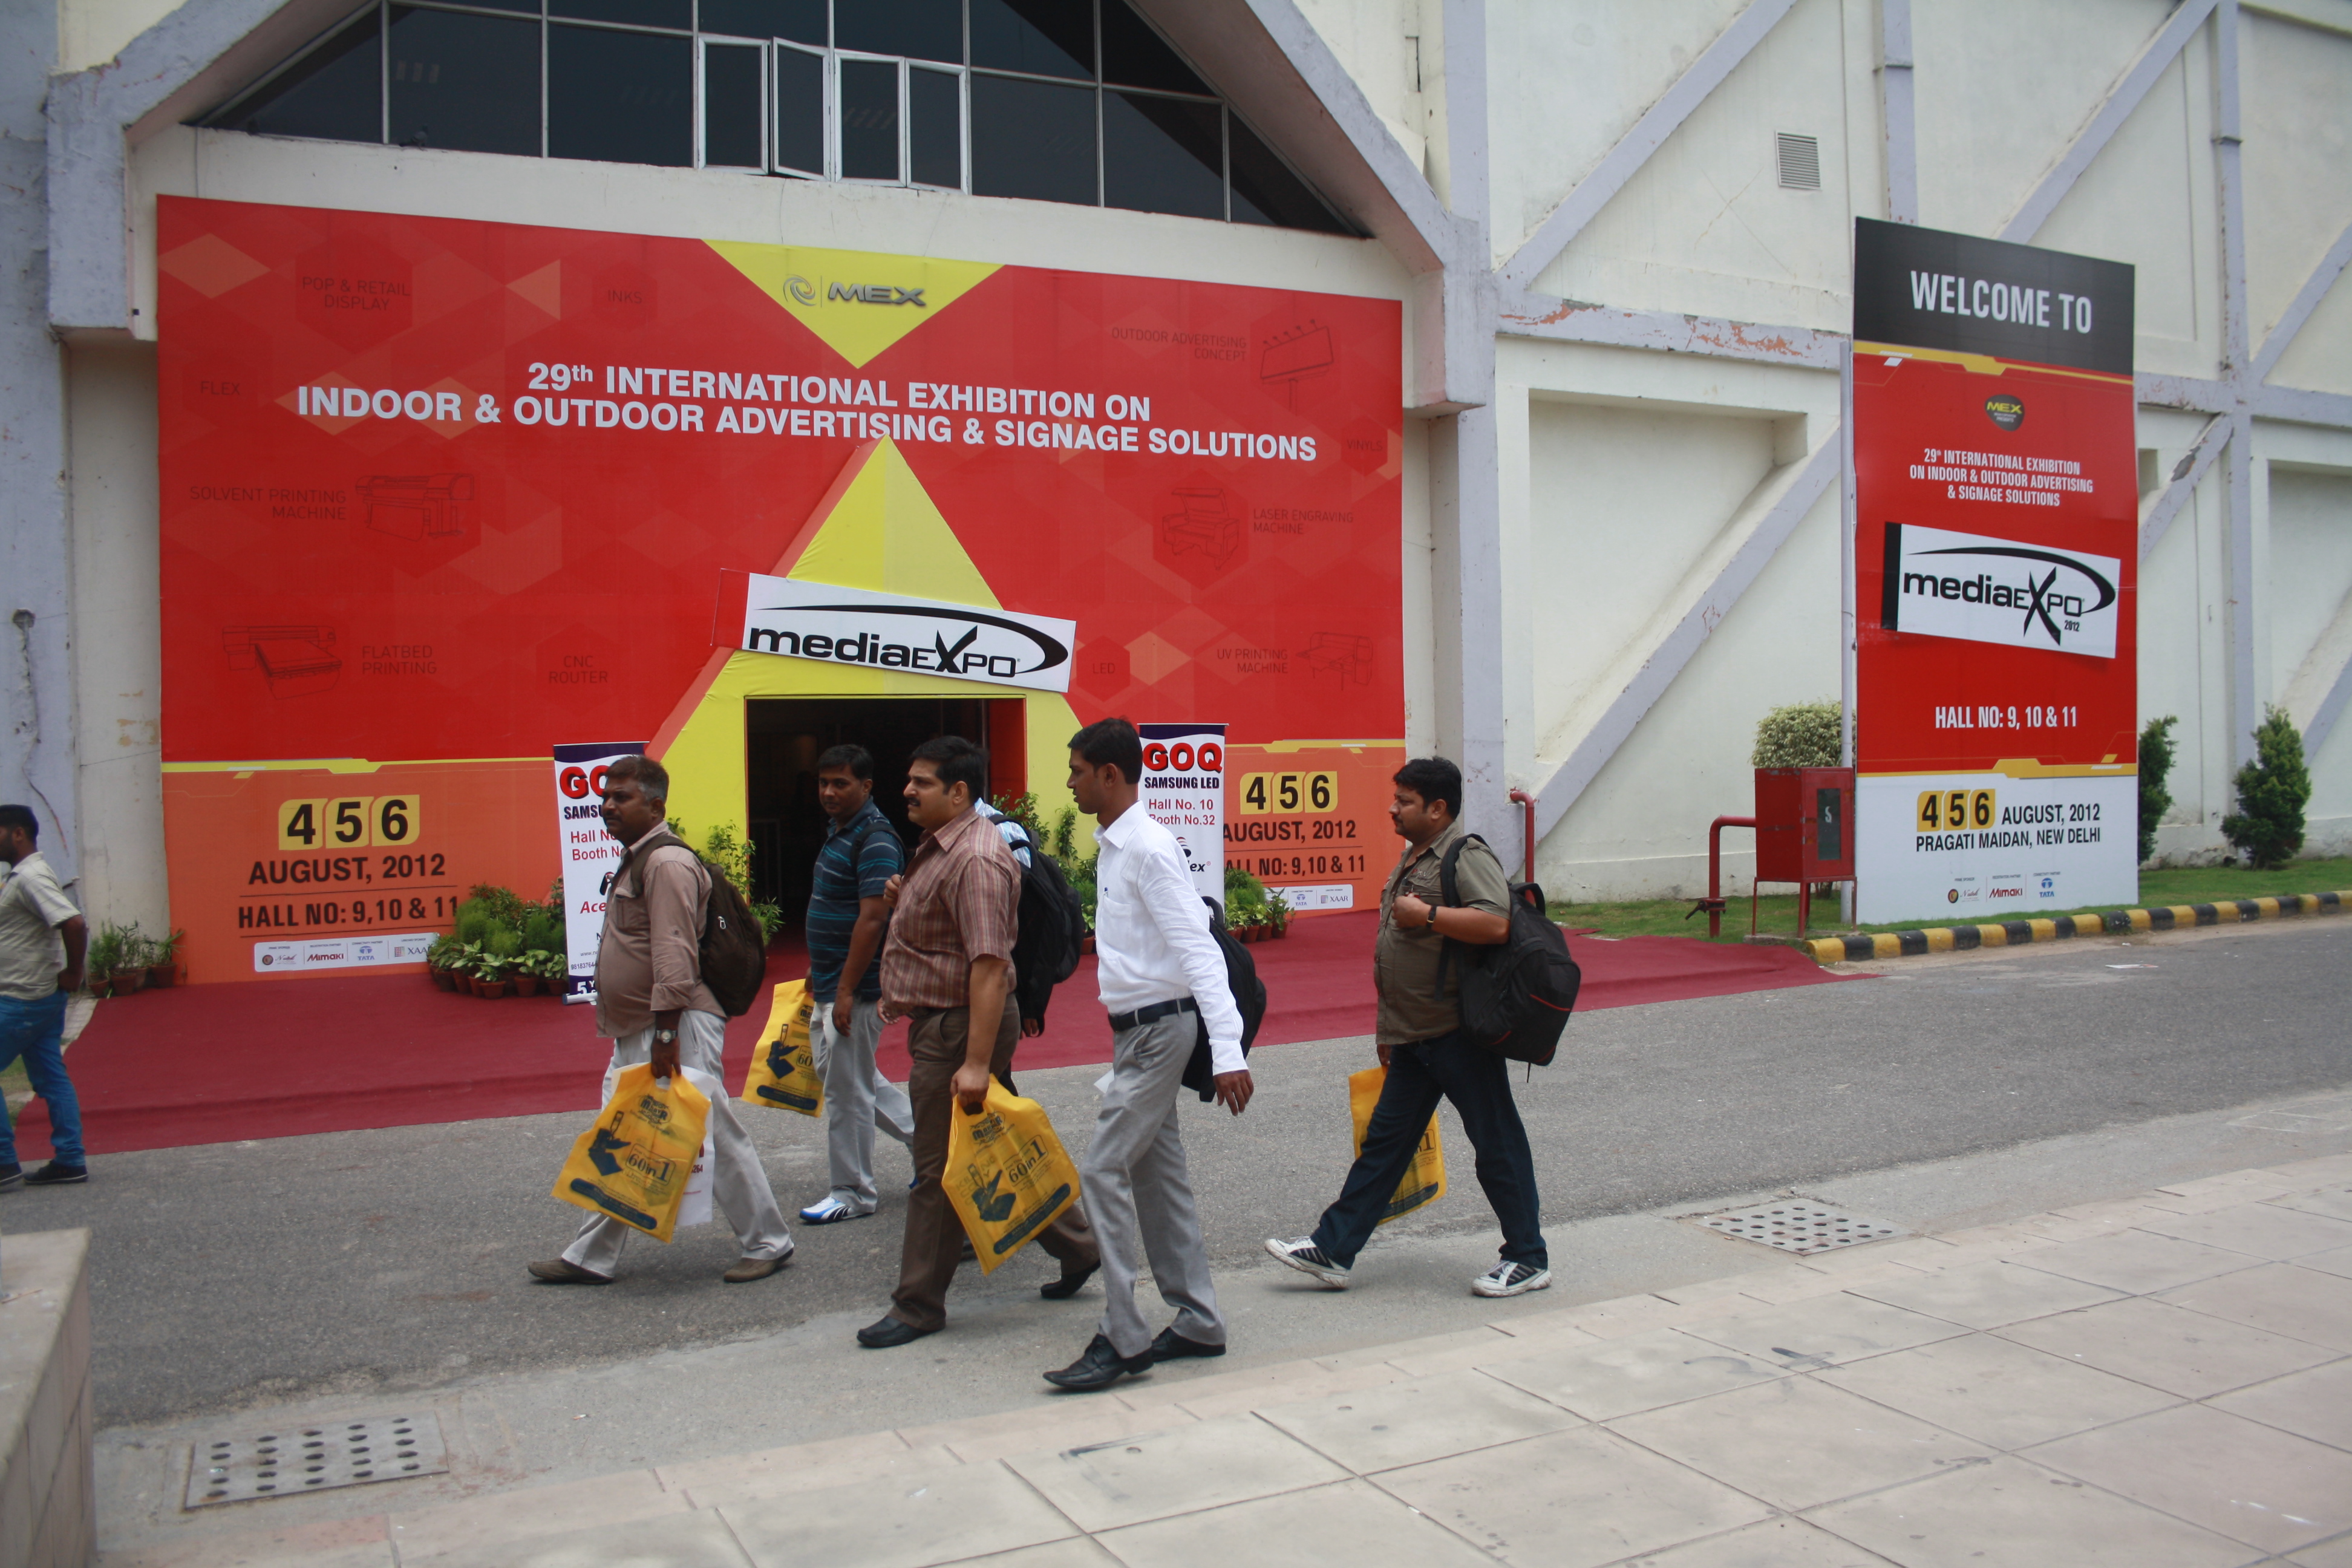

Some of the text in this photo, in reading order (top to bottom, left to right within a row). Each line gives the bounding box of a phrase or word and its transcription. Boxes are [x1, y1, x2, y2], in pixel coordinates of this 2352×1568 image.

[302, 276, 411, 297] POP & RETAIL
[828, 281, 927, 307] MEX
[324, 294, 390, 311] DISPLAY
[607, 289, 643, 304] INKS
[1910, 270, 2092, 334] WELCOME TO
[1111, 327, 1247, 348] OUTDOOR ADVERTISING
[1194, 347, 1246, 362] CONCEPT
[200, 380, 241, 396] FLEX
[528, 362, 1151, 422] 29th INTERNATIONAL EXHIBITION ON
[1987, 401, 2022, 414] MEX
[298, 385, 1317, 462] INDOOR & OUTDOOR ADVERTISING & SIGNAGE SOLUTIONS
[1346, 437, 1383, 452] VINYLS
[1944, 449, 2024, 471] INTERNATIONAL
[2026, 456, 2080, 475] EXHIBITION
[1909, 464, 2093, 494] ON INDOOR & OUTDOOR ADVERTISING
[189, 486, 347, 504] SOLVENT PRINTING
[1947, 485, 2060, 507] & SIGNAGE SOLUTIONS
[272, 505, 347, 521] MACHINE
[1253, 508, 1354, 523] LASER ENGRAVING
[1253, 521, 1304, 535] MACHINE
[2064, 619, 2080, 632] 2012
[362, 645, 433, 659] FLATBED
[1217, 648, 1288, 661] UV PRINTING
[362, 661, 437, 675] PRINTING
[563, 654, 593, 668] CNC
[1092, 662, 1116, 675] LED
[1237, 662, 1289, 674] MACHINE
[548, 670, 608, 684] ROUTER
[1935, 706, 2077, 730] HALL NO: 9, 10 & 11
[1143, 742, 1223, 774] GOQ
[560, 765, 610, 799] GO
[1145, 777, 1220, 789] SAMSUNG LED
[1246, 774, 1330, 810] 4 5 6
[564, 804, 603, 820] SAMS
[1149, 799, 1214, 810] Hall No. 10
[1921, 791, 2100, 828] 4 5 6 AUGUST, 2012
[287, 799, 409, 845] 4 5 6
[1184, 814, 1215, 825] No.32
[570, 829, 595, 843] Hall
[1223, 819, 1356, 844] AUGUST, 2012
[1916, 826, 2100, 852] PRAGATI MAIDAN, NEW DELHI
[572, 847, 607, 861] Booth
[248, 853, 446, 885] AUGUST, 2012
[1225, 859, 1255, 876] AL
[1259, 857, 1288, 876] NO:
[1330, 856, 1343, 873] &
[1348, 855, 1365, 872] 11
[238, 904, 299, 929] HALL
[305, 902, 347, 926] NO:
[408, 897, 427, 920] &
[434, 895, 458, 918] 11
[407, 946, 430, 955] XAA
